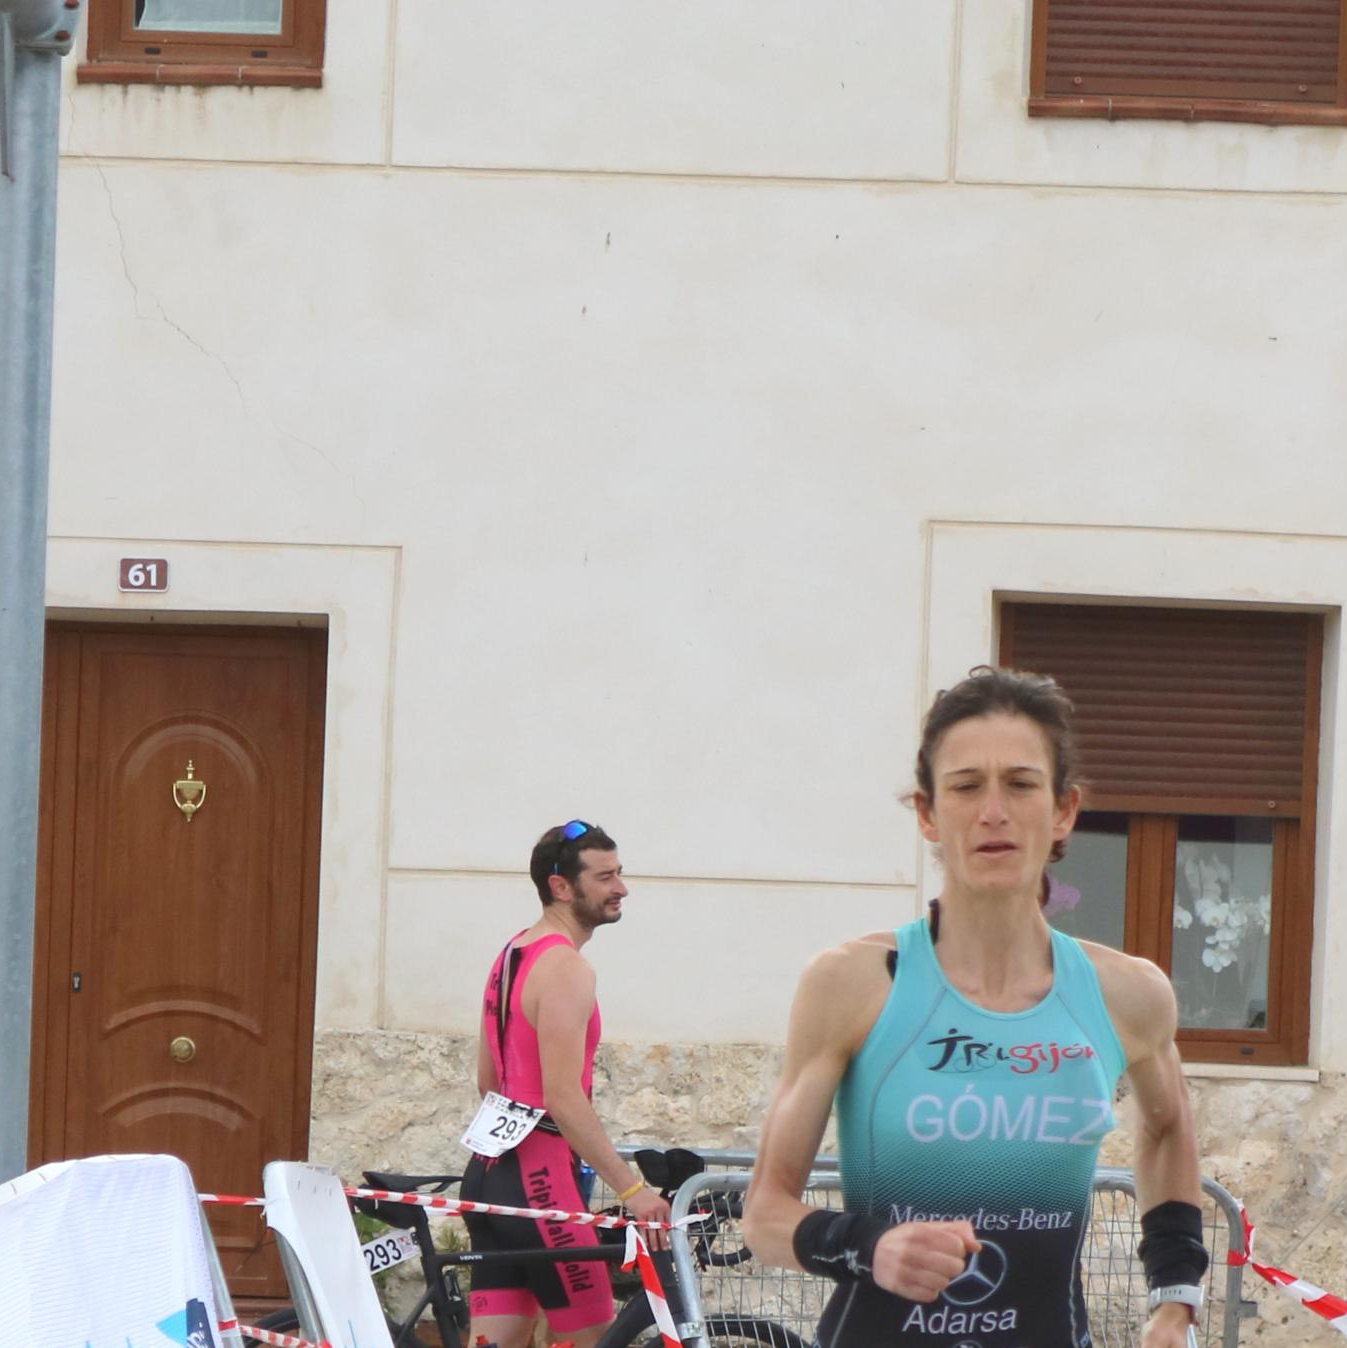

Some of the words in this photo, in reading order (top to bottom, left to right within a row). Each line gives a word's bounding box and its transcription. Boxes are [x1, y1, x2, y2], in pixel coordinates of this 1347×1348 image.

[128, 563, 157, 587] 61
[488, 1115, 528, 1141] 293
[907, 1084, 1109, 1145] GÓMEZ
[363, 1239, 402, 1271] 293
[902, 1304, 1018, 1334] Adarsa
